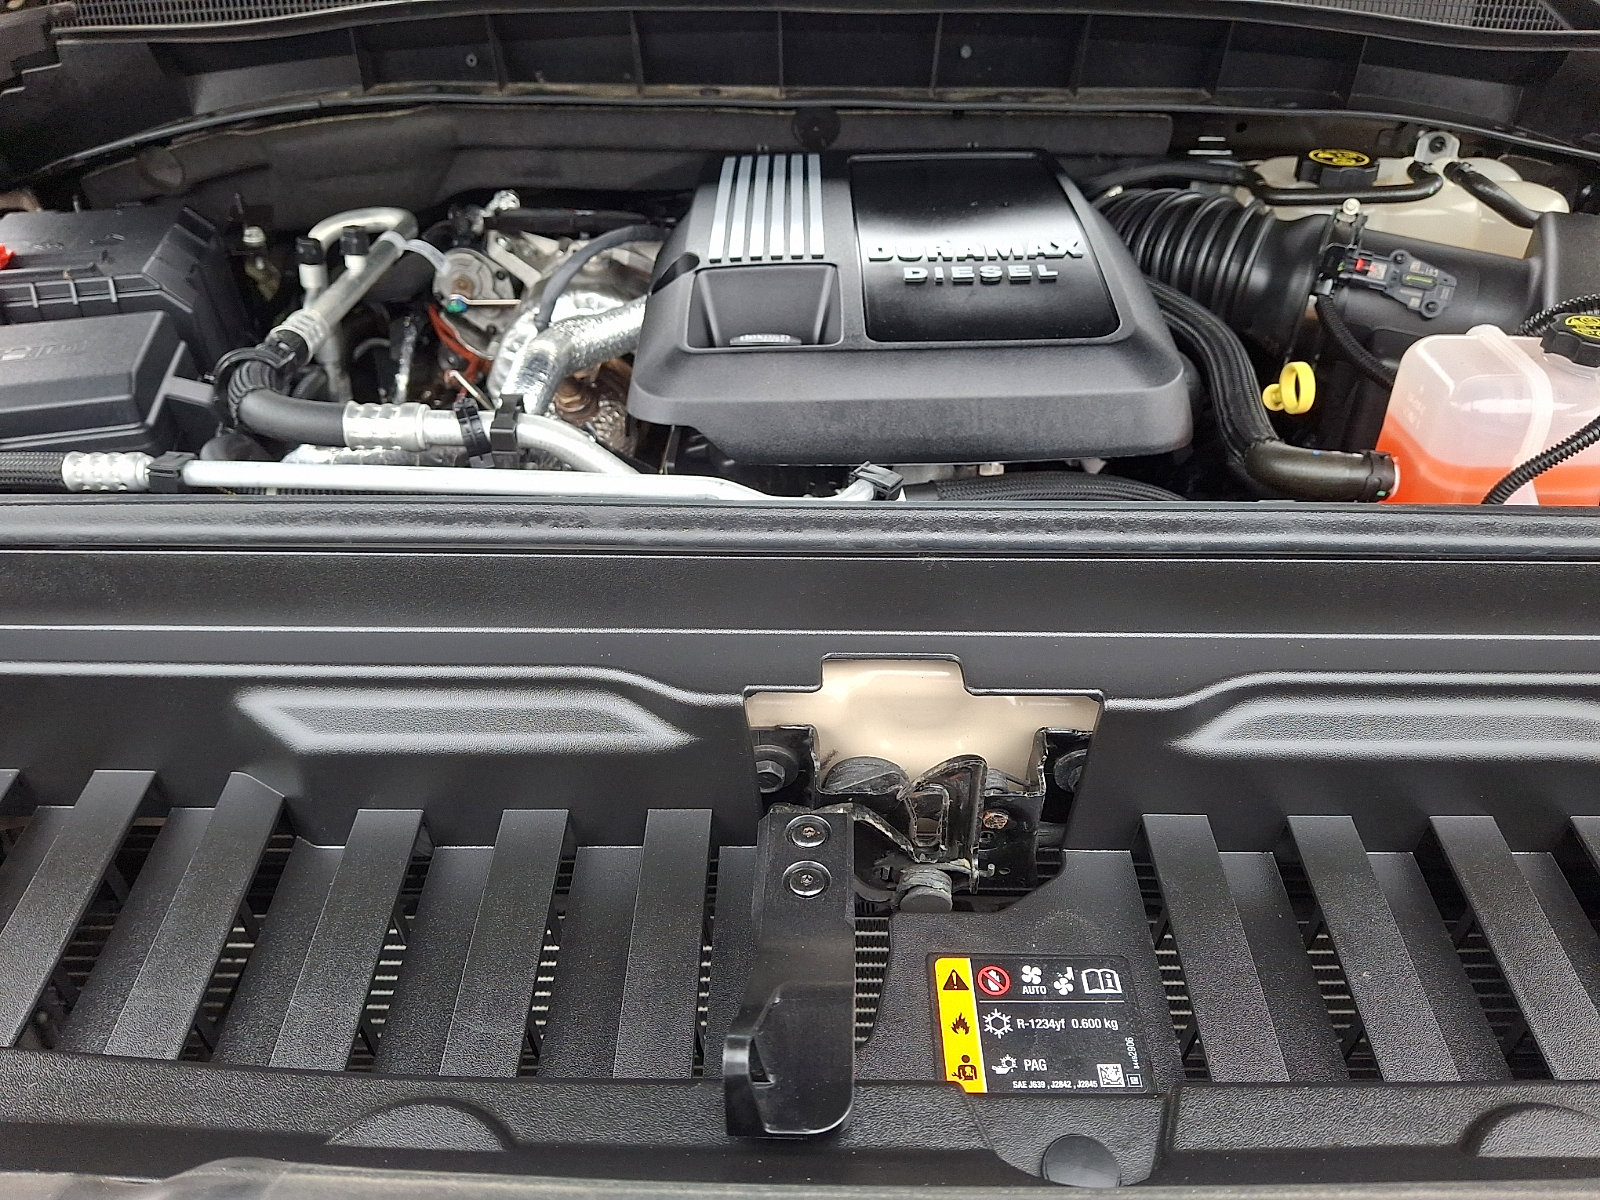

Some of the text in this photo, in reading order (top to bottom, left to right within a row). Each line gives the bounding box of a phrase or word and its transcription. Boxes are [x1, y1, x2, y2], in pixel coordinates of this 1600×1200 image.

[868, 239, 1083, 262] DURAMAX
[903, 265, 1059, 284] DIESEL
[1022, 985, 1047, 995] AUTO
[1017, 1018, 1119, 1031] R-1234yf 0.600 kg
[1023, 1059, 1048, 1071] PAG
[1012, 1080, 1028, 1089] SAE
